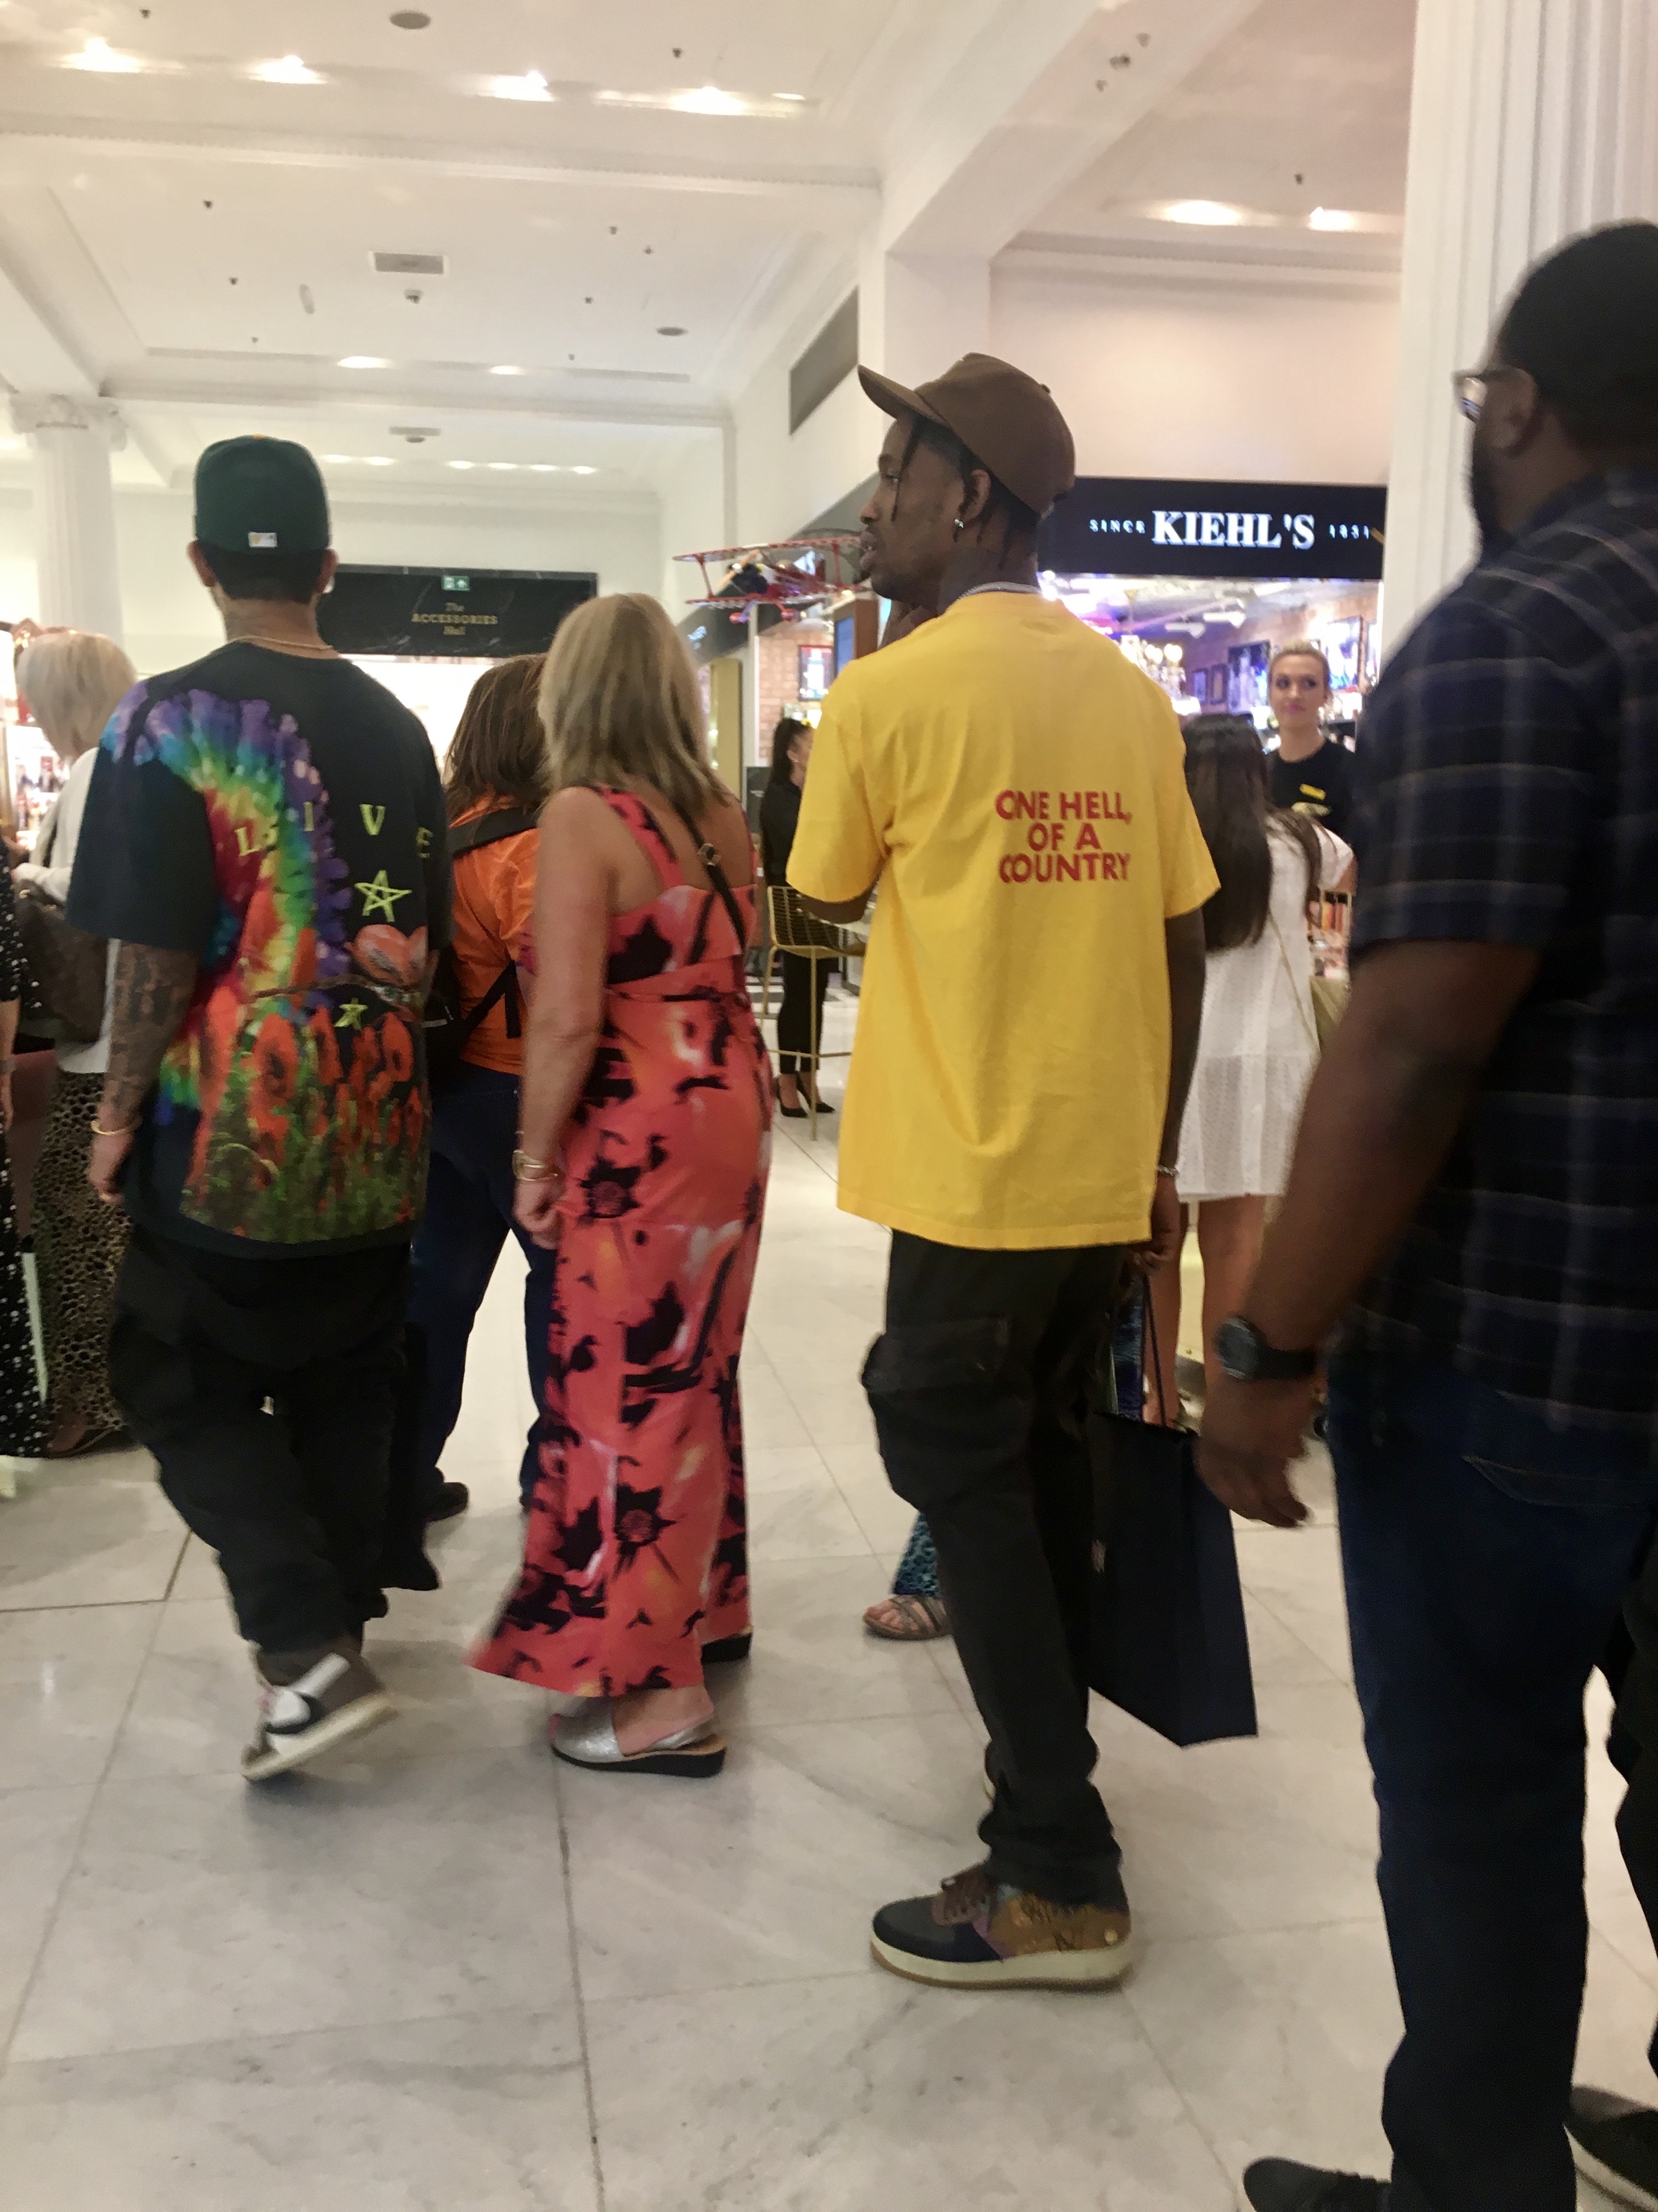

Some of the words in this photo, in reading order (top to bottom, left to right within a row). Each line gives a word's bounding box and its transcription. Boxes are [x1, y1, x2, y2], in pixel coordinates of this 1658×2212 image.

[1152, 510, 1315, 549] KIEHL'S
[995, 789, 1049, 820] ONE
[1027, 822, 1064, 851] OF
[1074, 822, 1102, 850] A
[998, 852, 1131, 884] COUNTRY
